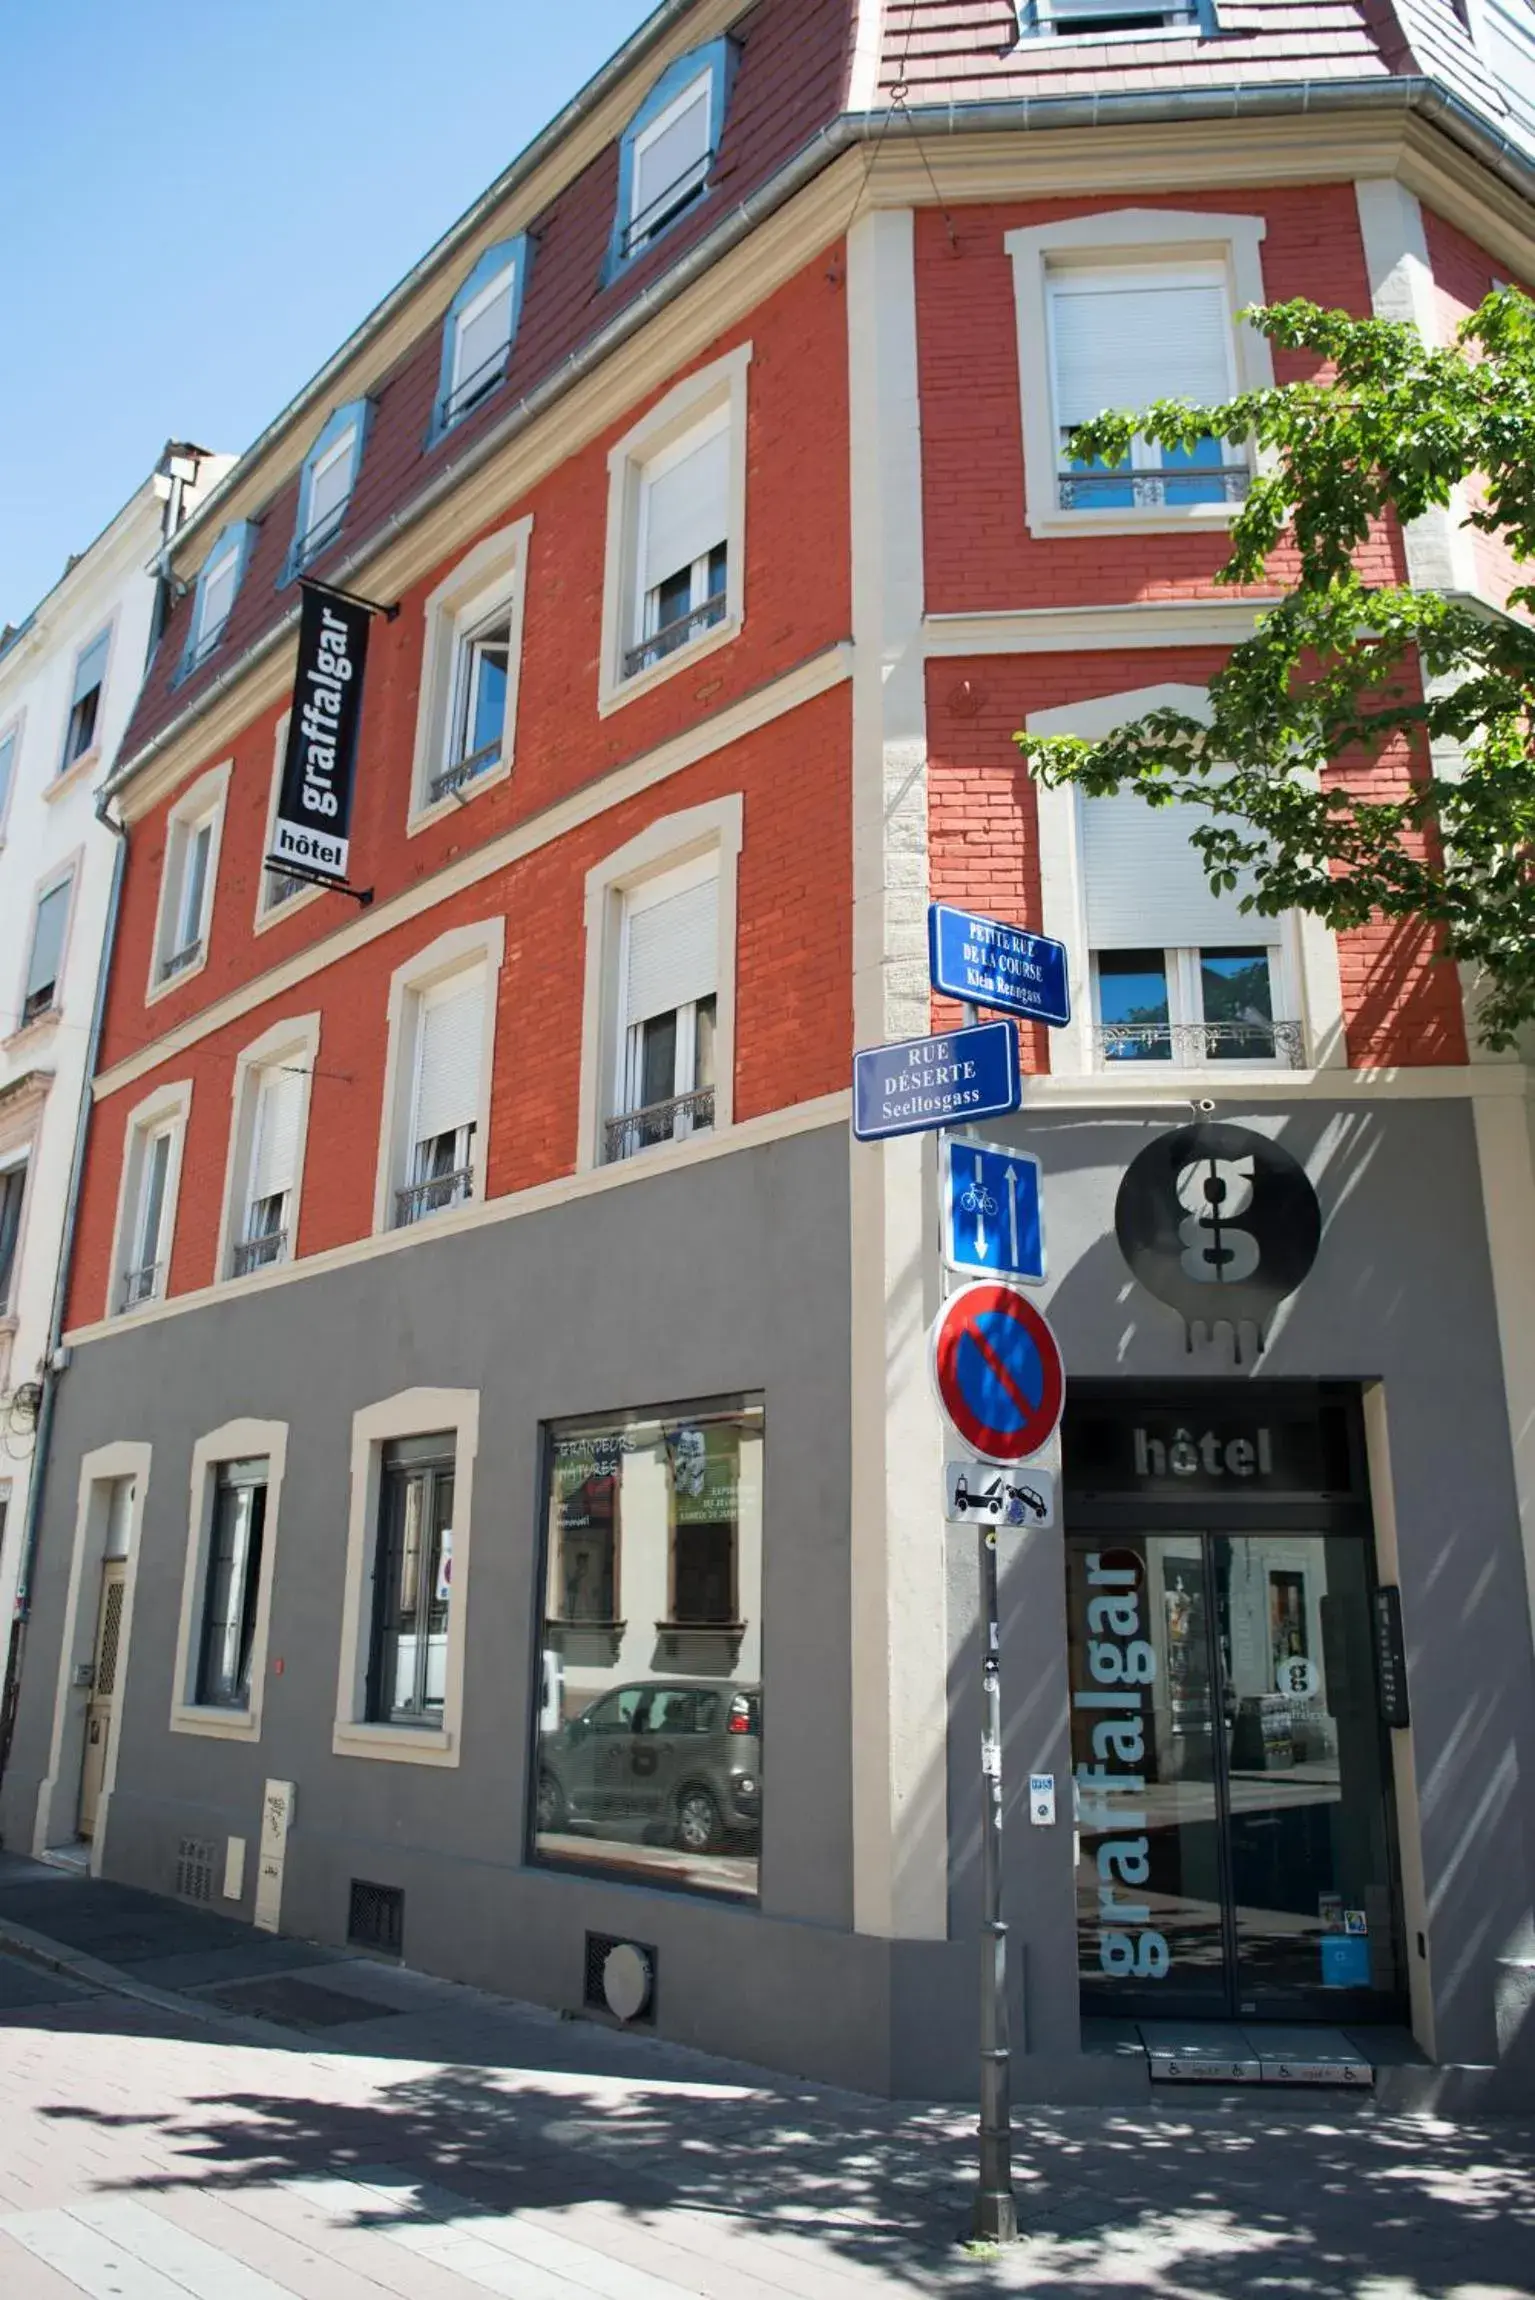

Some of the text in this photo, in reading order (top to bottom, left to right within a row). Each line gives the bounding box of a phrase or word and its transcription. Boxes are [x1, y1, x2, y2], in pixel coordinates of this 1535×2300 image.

[300, 606, 353, 818] graffalgar
[279, 828, 343, 866] hôtel
[969, 921, 1036, 958] PETITE RUE
[963, 943, 1044, 983] DE LA COURSE
[966, 968, 1043, 1004] Klein Renngass
[908, 1041, 950, 1067] RUE
[884, 1060, 977, 1096] DÉSERTE
[882, 1088, 981, 1119] Seellosgass
[1132, 1427, 1273, 1477] hôtel
[1073, 1551, 1171, 1979] graffalgar
